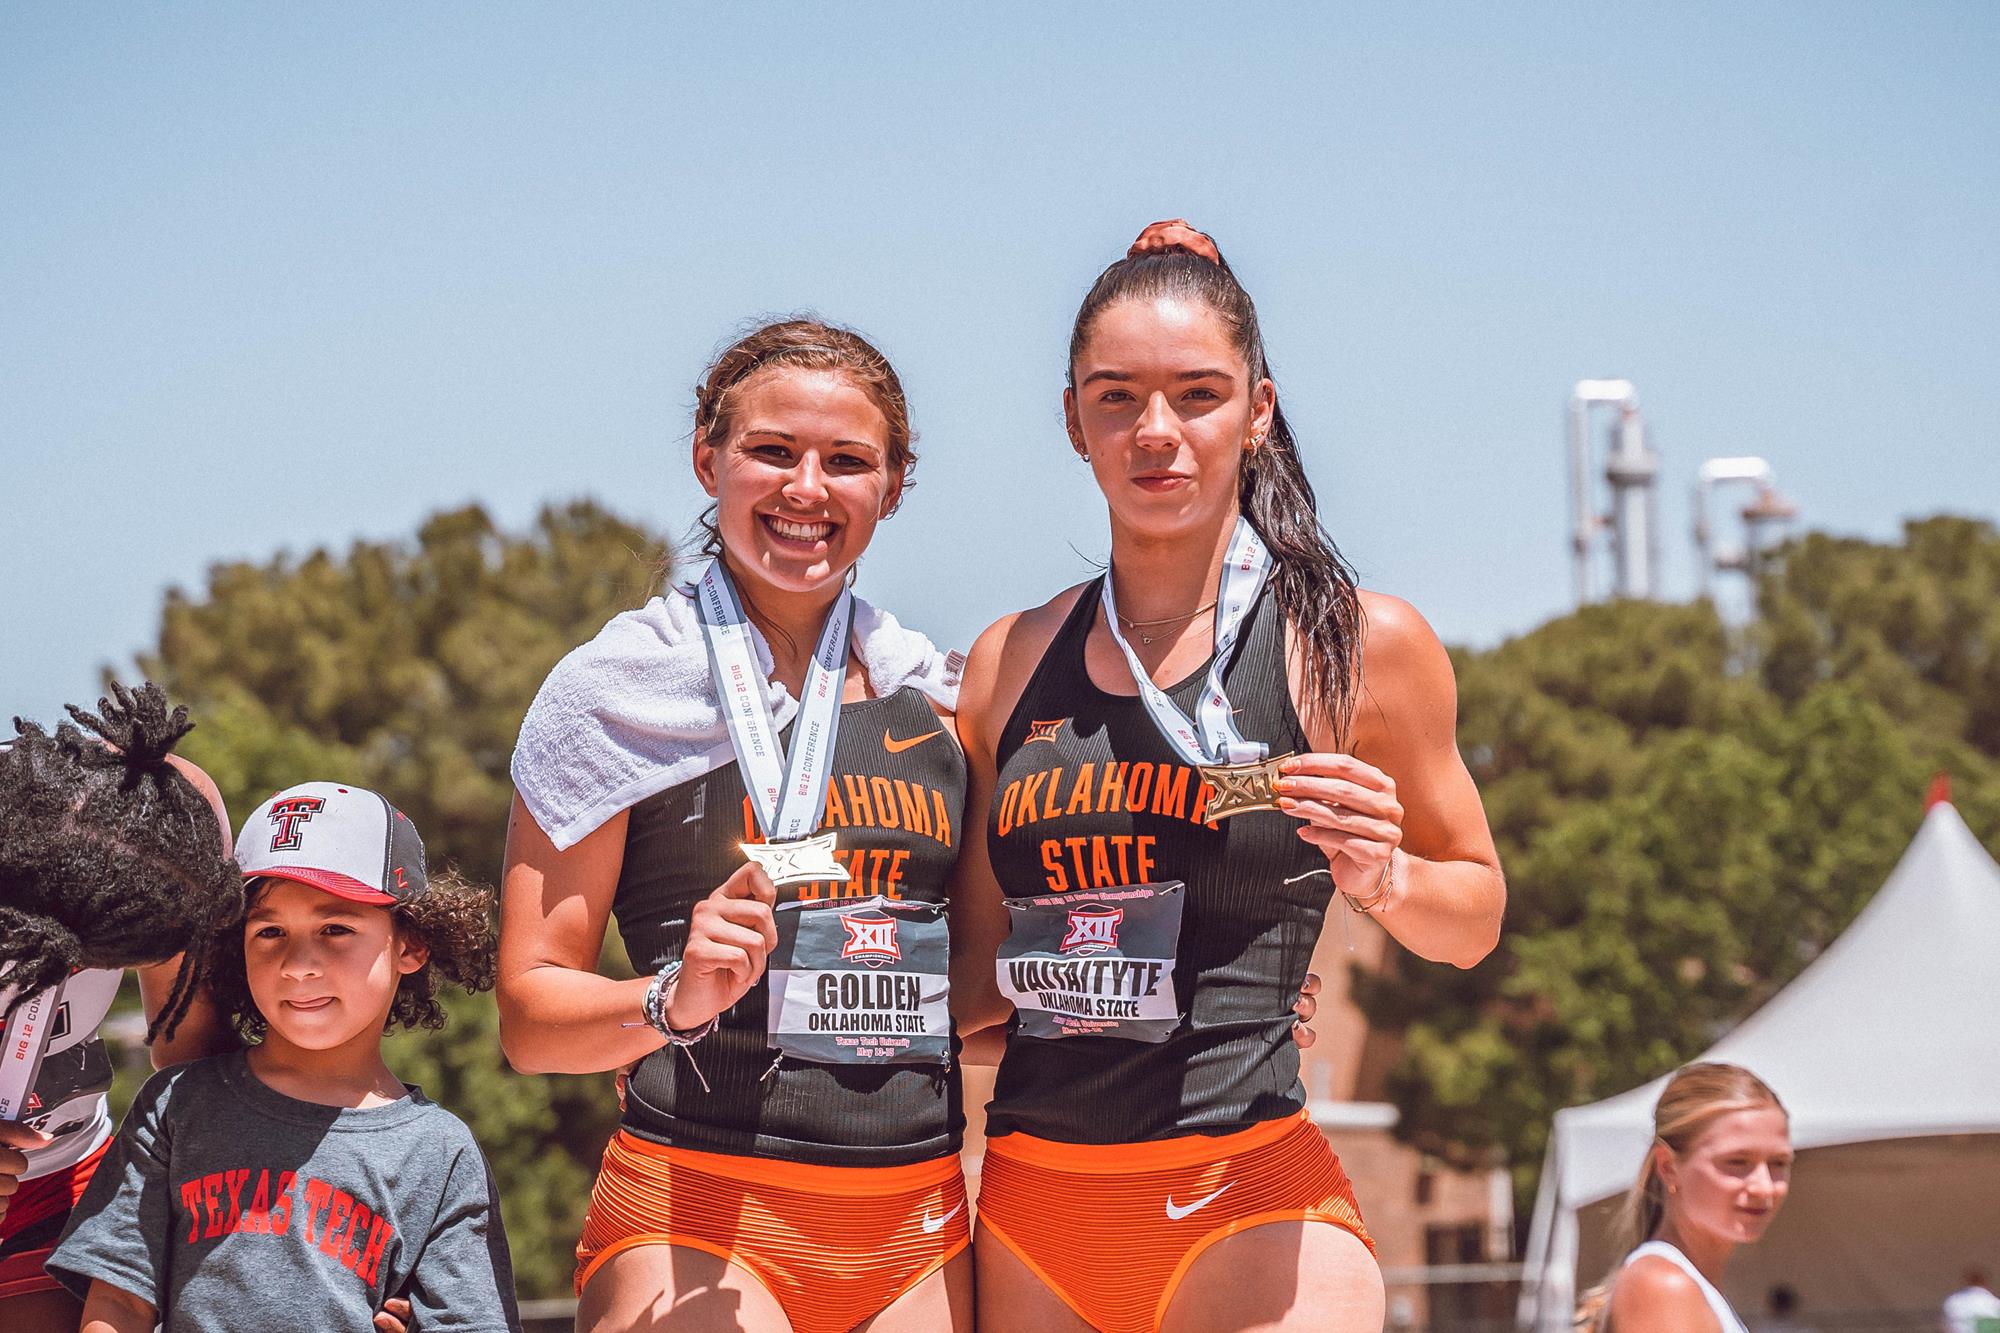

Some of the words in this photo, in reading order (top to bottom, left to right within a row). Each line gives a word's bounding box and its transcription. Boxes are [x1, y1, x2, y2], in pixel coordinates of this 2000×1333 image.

[707, 585, 730, 635] CONFERENCE
[823, 618, 842, 672] CONFERENCE
[731, 665, 743, 680] BIG
[736, 682, 747, 693] 12
[821, 672, 830, 682] 12
[818, 684, 828, 698] BIG
[803, 721, 820, 772] CONFERENCE
[798, 782, 809, 796] BIG
[998, 762, 1219, 837] OKLAHOMA
[1041, 835, 1156, 892] STATE
[1099, 889, 1154, 901] Championships
[845, 921, 894, 953] XII
[1065, 914, 1121, 945] XII
[817, 972, 921, 1012] GOLDEN
[1008, 960, 1163, 997] VAITAITYTE
[1038, 992, 1093, 1017] OKLAHOMA
[1096, 998, 1140, 1018] STATE
[808, 1012, 893, 1032] OKLAHOMA
[895, 1014, 927, 1033] STATE
[15, 1041, 28, 1061] BIG
[23, 1024, 34, 1039] 12
[835, 1036, 859, 1046] Texas
[860, 1036, 879, 1046] Tech
[879, 1036, 910, 1049] University
[856, 1046, 873, 1058] May
[181, 1168, 298, 1244] TEXAS
[304, 1176, 395, 1289] TECH
